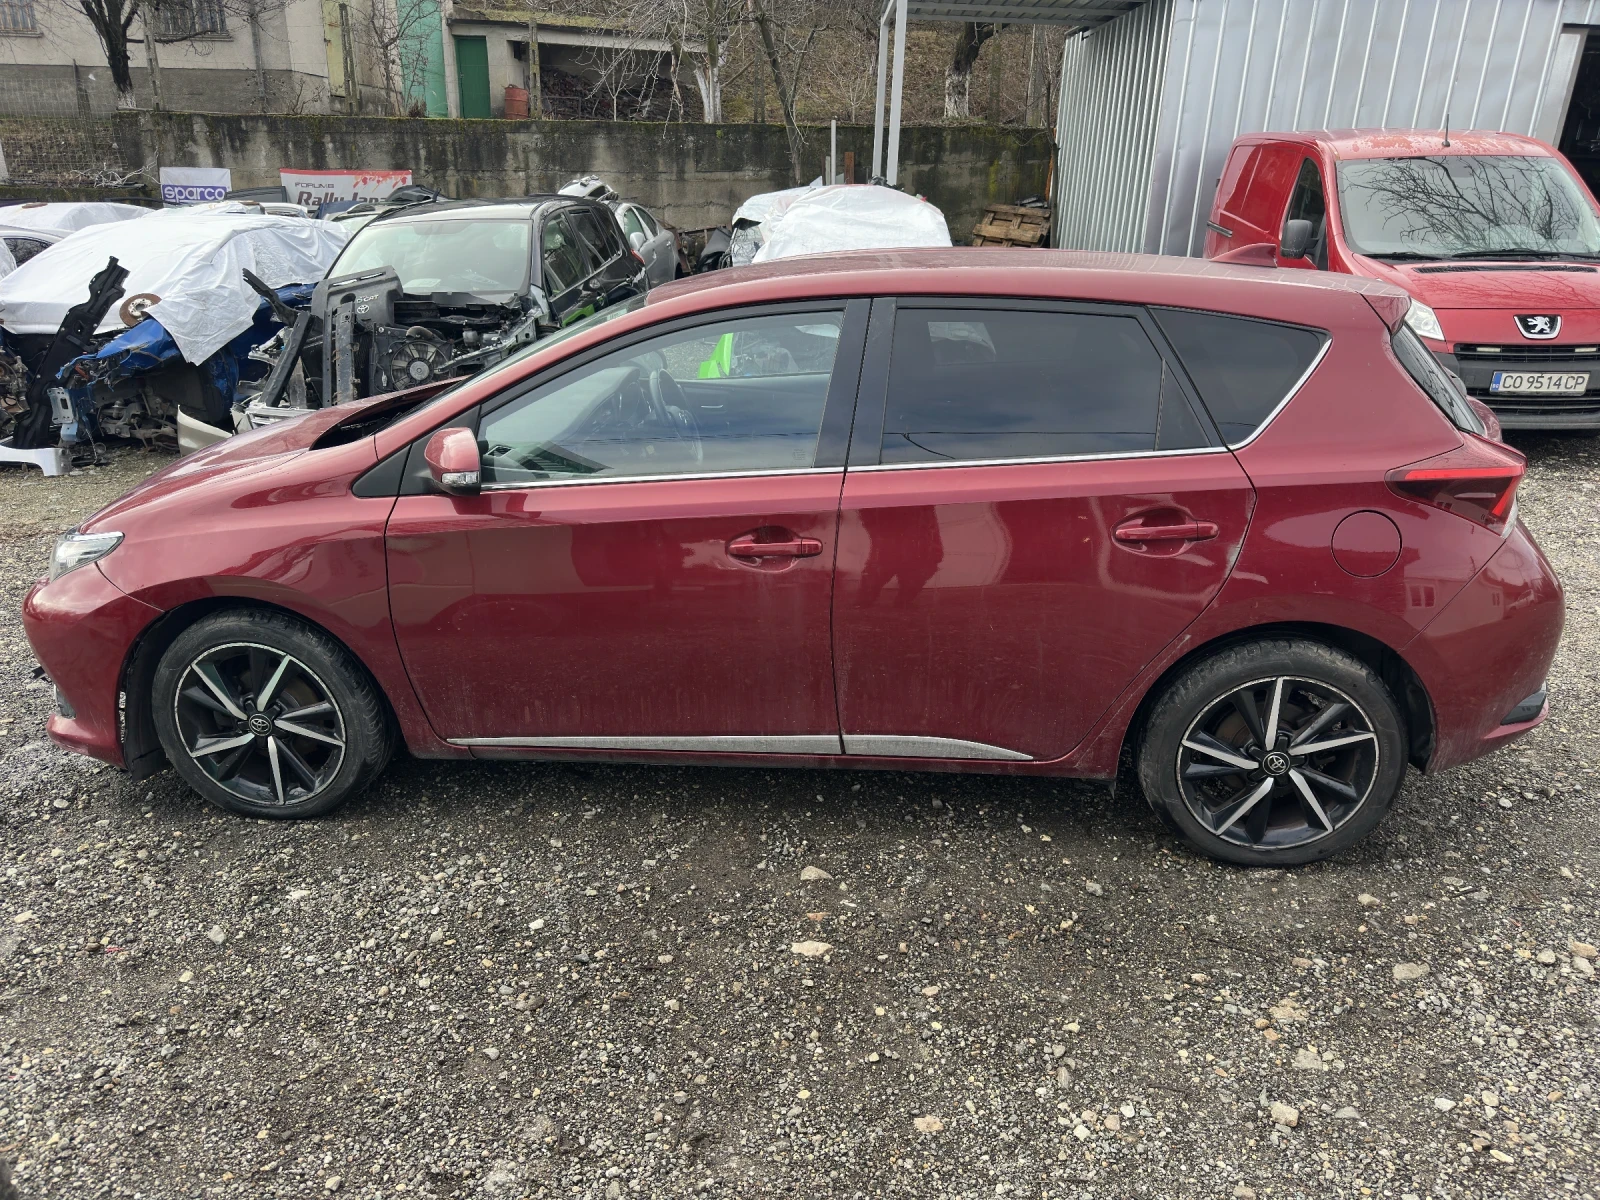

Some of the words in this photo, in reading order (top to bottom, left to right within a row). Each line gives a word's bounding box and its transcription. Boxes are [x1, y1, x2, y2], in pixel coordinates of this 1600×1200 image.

[164, 186, 225, 203] sparco
[1502, 375, 1523, 389] CO
[1526, 375, 1562, 390] 9514
[1564, 375, 1586, 390] CP
